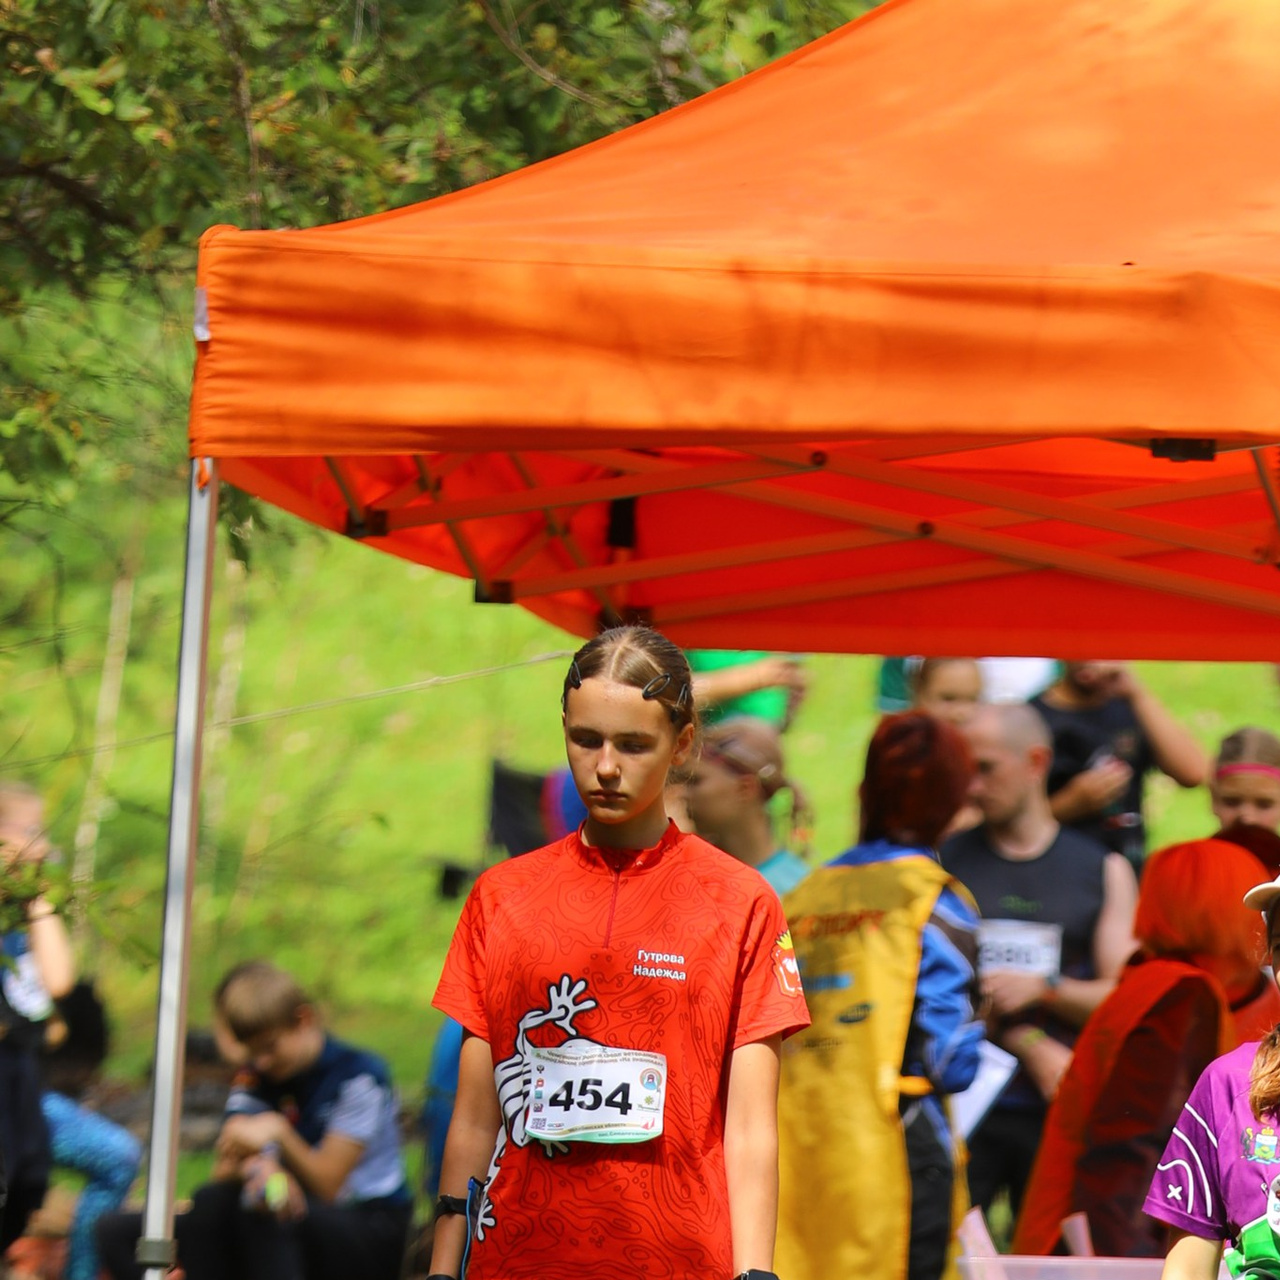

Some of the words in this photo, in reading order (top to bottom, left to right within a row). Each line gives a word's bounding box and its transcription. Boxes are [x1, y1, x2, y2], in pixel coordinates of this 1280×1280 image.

[637, 949, 685, 965] Гутрова
[633, 964, 687, 981] Надежда
[549, 1078, 632, 1115] 454
